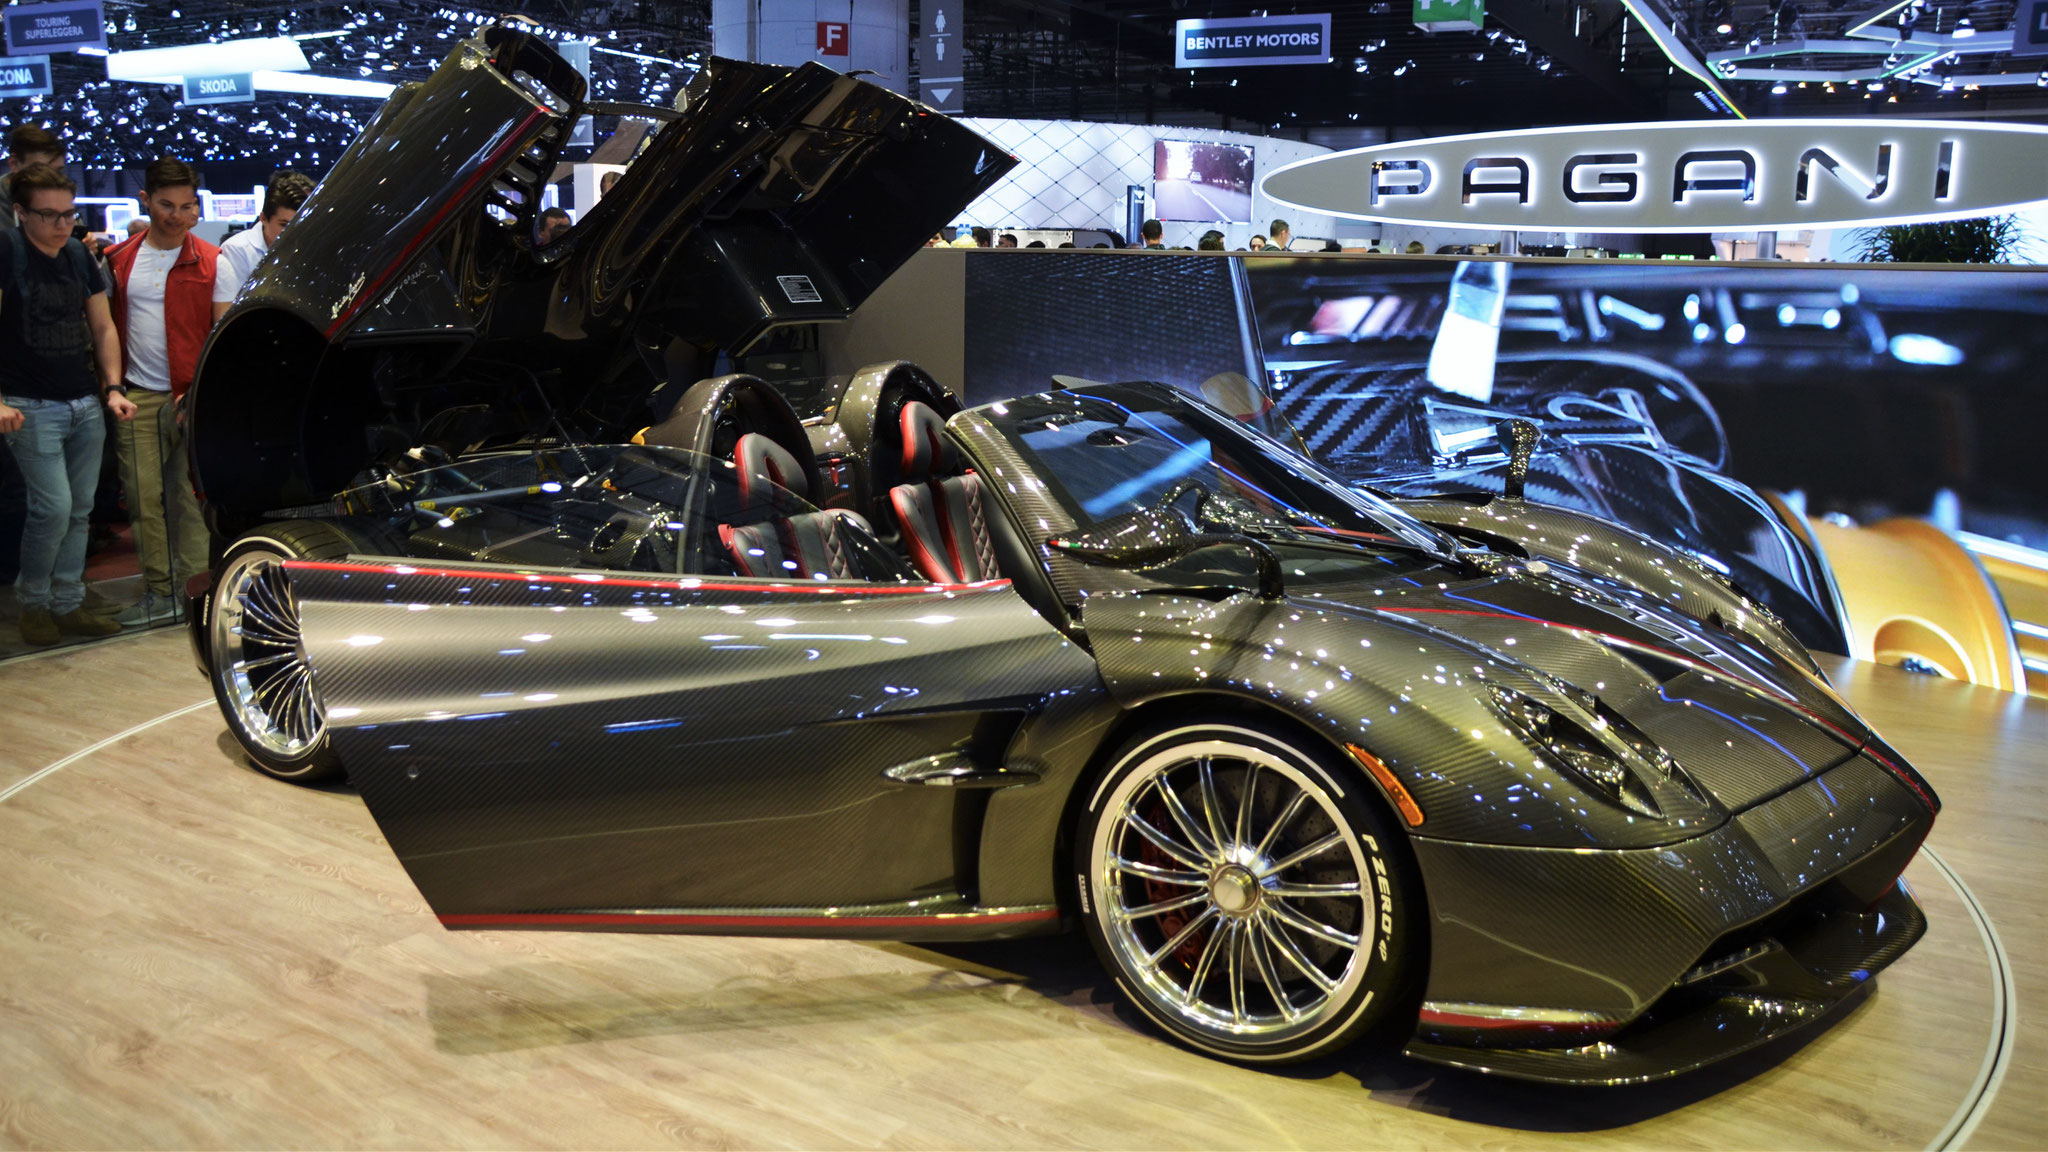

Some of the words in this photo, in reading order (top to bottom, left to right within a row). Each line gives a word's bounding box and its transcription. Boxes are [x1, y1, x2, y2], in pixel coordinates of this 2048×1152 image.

[35, 16, 71, 28] TOURING
[25, 26, 84, 40] SUPERLEGGERA
[826, 25, 842, 47] F
[1186, 35, 1253, 50] BENTLEY
[1256, 32, 1320, 47] MOTORS
[1370, 140, 1956, 206] PAGANI
[1361, 833, 1379, 852] P
[1371, 856, 1392, 935] ZERO
